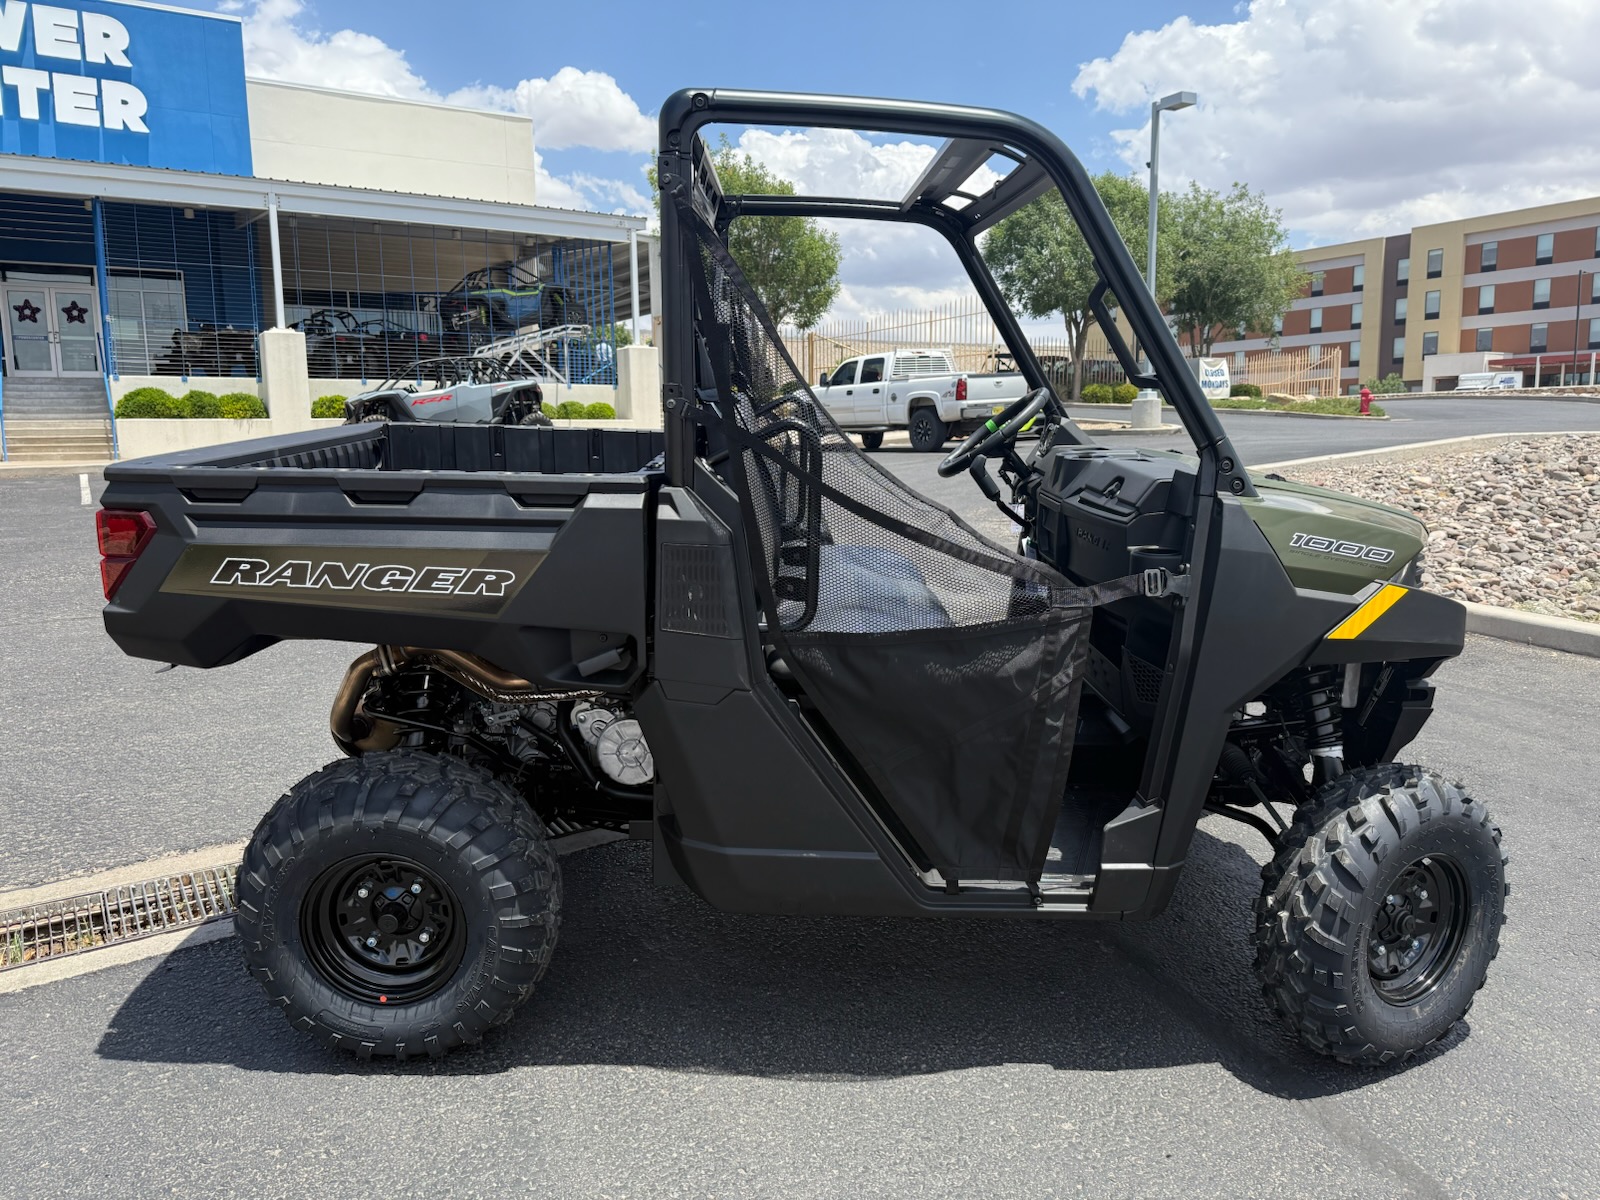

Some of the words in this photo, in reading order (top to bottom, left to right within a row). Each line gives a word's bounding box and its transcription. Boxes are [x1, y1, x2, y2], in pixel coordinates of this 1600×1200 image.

[0, 64, 150, 134] TER
[1205, 369, 1224, 377] CLOSED
[1201, 380, 1229, 389] MONDAYS
[1289, 532, 1395, 563] 1000
[1323, 555, 1368, 567] OVERHEAD
[210, 557, 516, 596] RANGER
